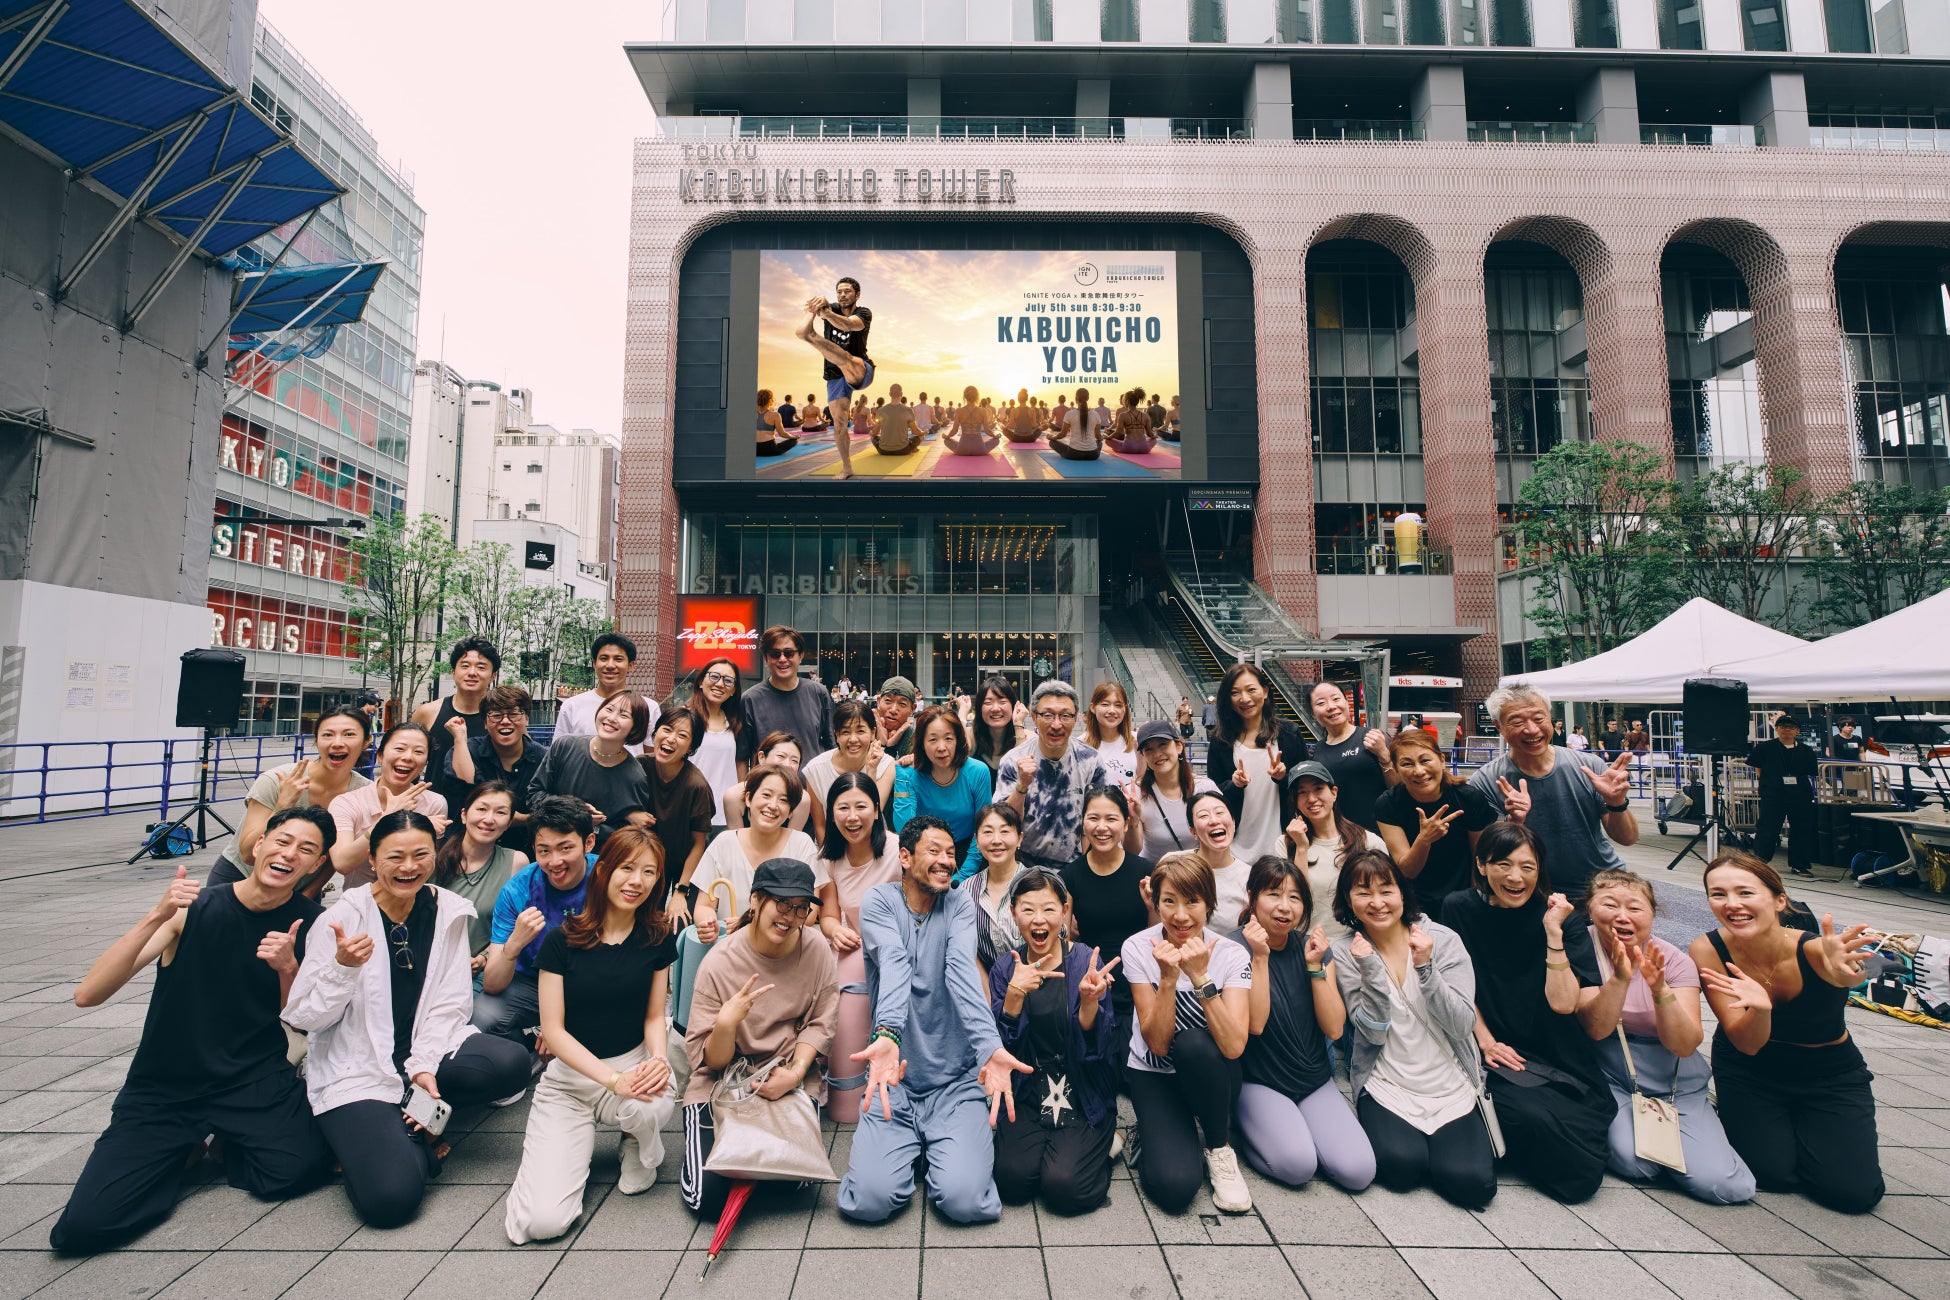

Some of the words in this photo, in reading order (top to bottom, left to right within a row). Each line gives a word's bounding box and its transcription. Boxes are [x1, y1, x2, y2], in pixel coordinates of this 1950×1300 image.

[680, 144, 758, 160] TOKYU
[679, 168, 878, 197] KABUKICHO
[895, 168, 1016, 198] TOWER
[1025, 303, 1046, 313] July
[1050, 303, 1066, 312] 5th
[1070, 304, 1088, 312] sun
[1092, 303, 1141, 312] 8:30-9:30
[998, 316, 1161, 343] KABUKICHO
[1042, 346, 1117, 373] YOGA
[1042, 375, 1052, 384] by
[1055, 375, 1076, 384] Kenji
[1079, 376, 1119, 384] Kureyama
[221, 435, 289, 488] KYO
[212, 524, 326, 579] STERY
[694, 574, 920, 594] STARBUCKS
[676, 628, 708, 643] Zepp
[708, 628, 759, 643] Shinjuku
